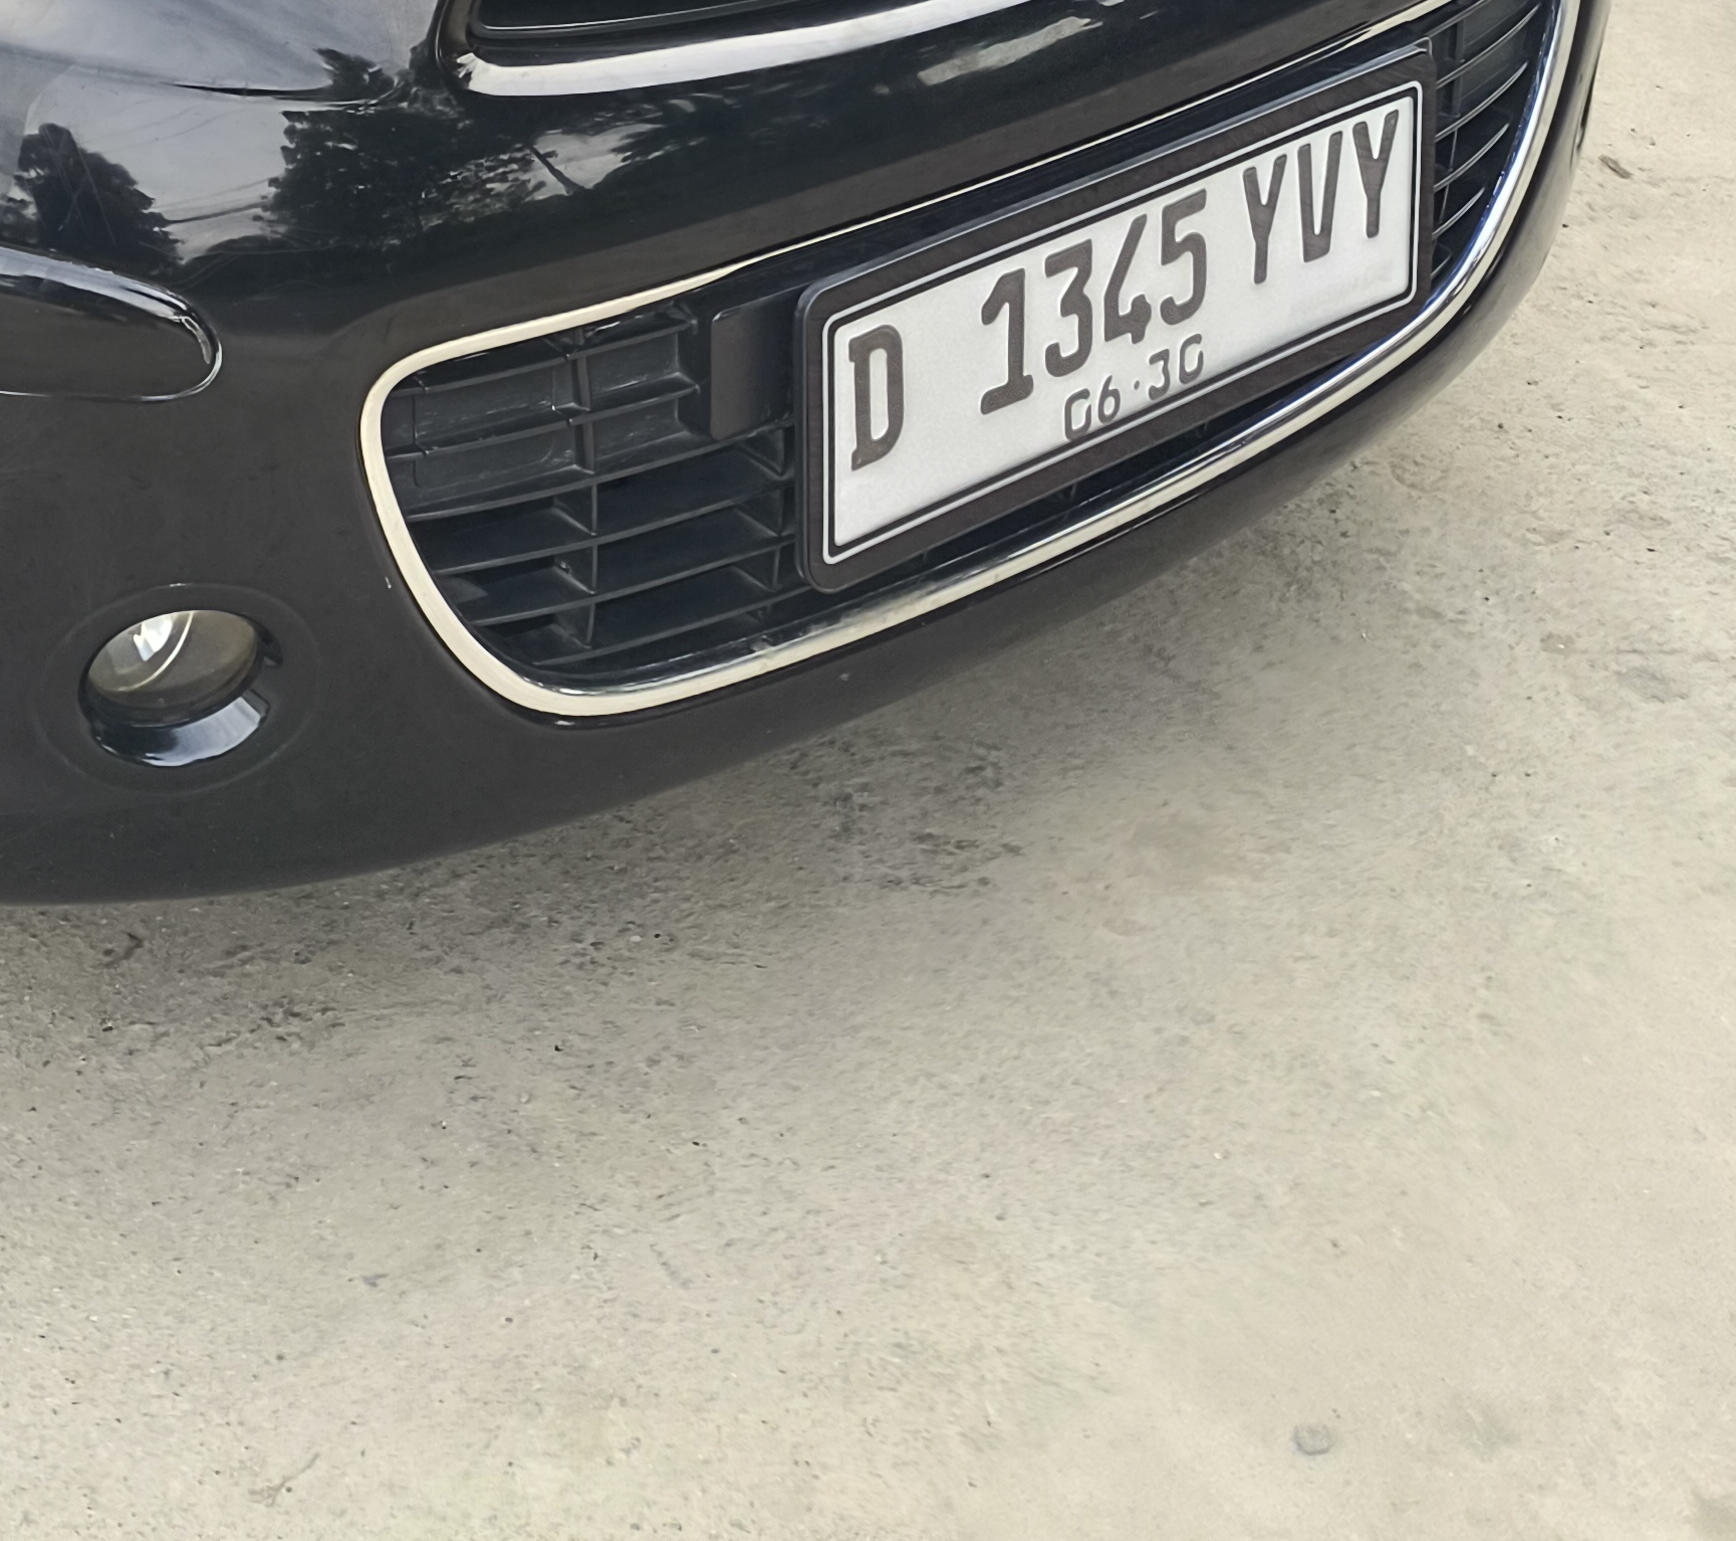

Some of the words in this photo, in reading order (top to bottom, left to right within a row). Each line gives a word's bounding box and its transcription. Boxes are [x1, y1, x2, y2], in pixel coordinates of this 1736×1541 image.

[848, 323, 905, 472] D
[979, 187, 1208, 416] 1345
[1241, 108, 1400, 286] YVY
